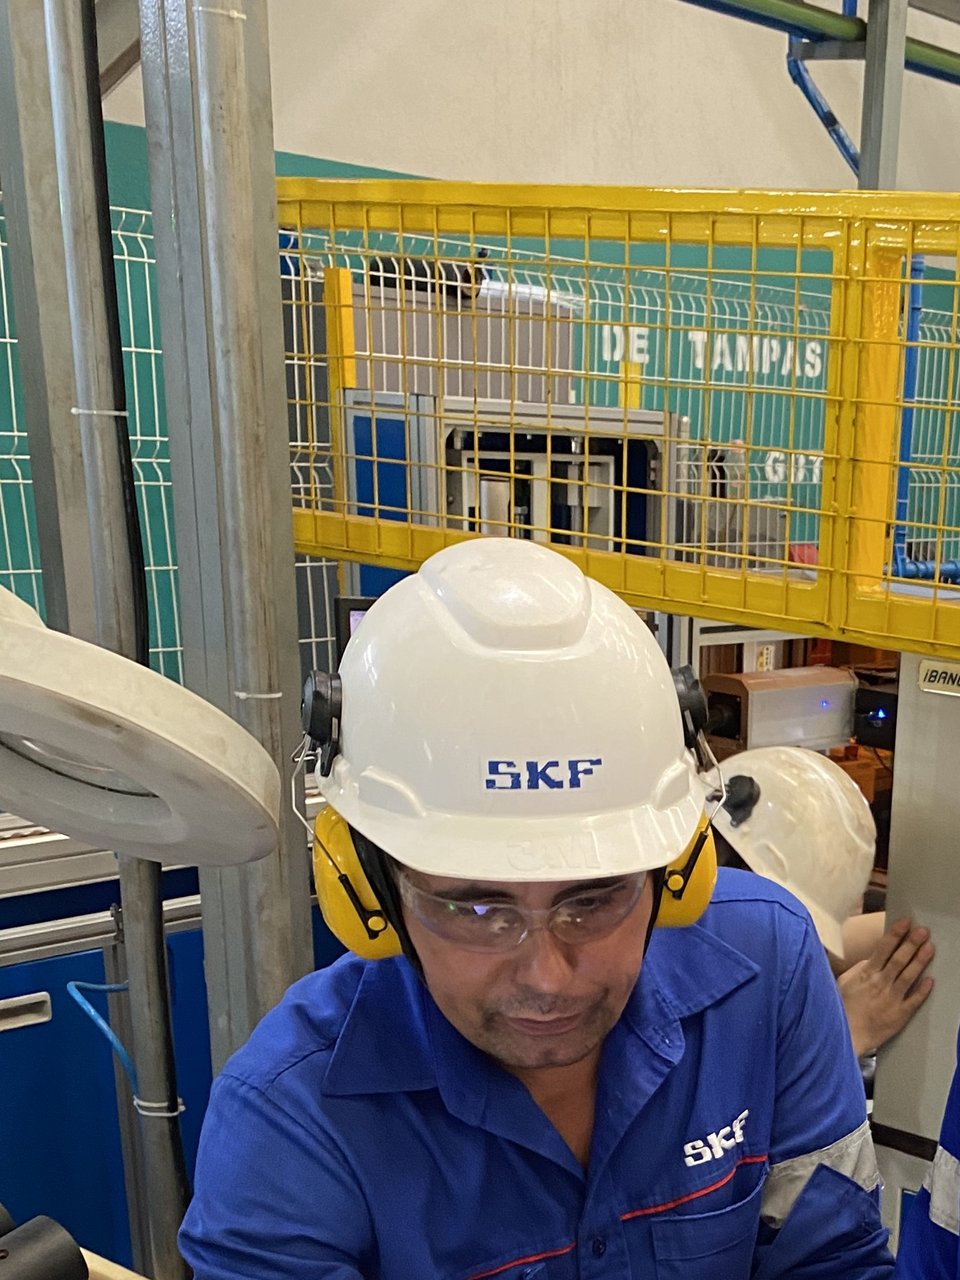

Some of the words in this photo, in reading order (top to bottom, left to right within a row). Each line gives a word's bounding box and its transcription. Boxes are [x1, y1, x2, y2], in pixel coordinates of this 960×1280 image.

[602, 325, 650, 364] DE
[688, 331, 823, 378] TAMPAS
[486, 758, 602, 789] SKF
[683, 1109, 749, 1167] SKF
